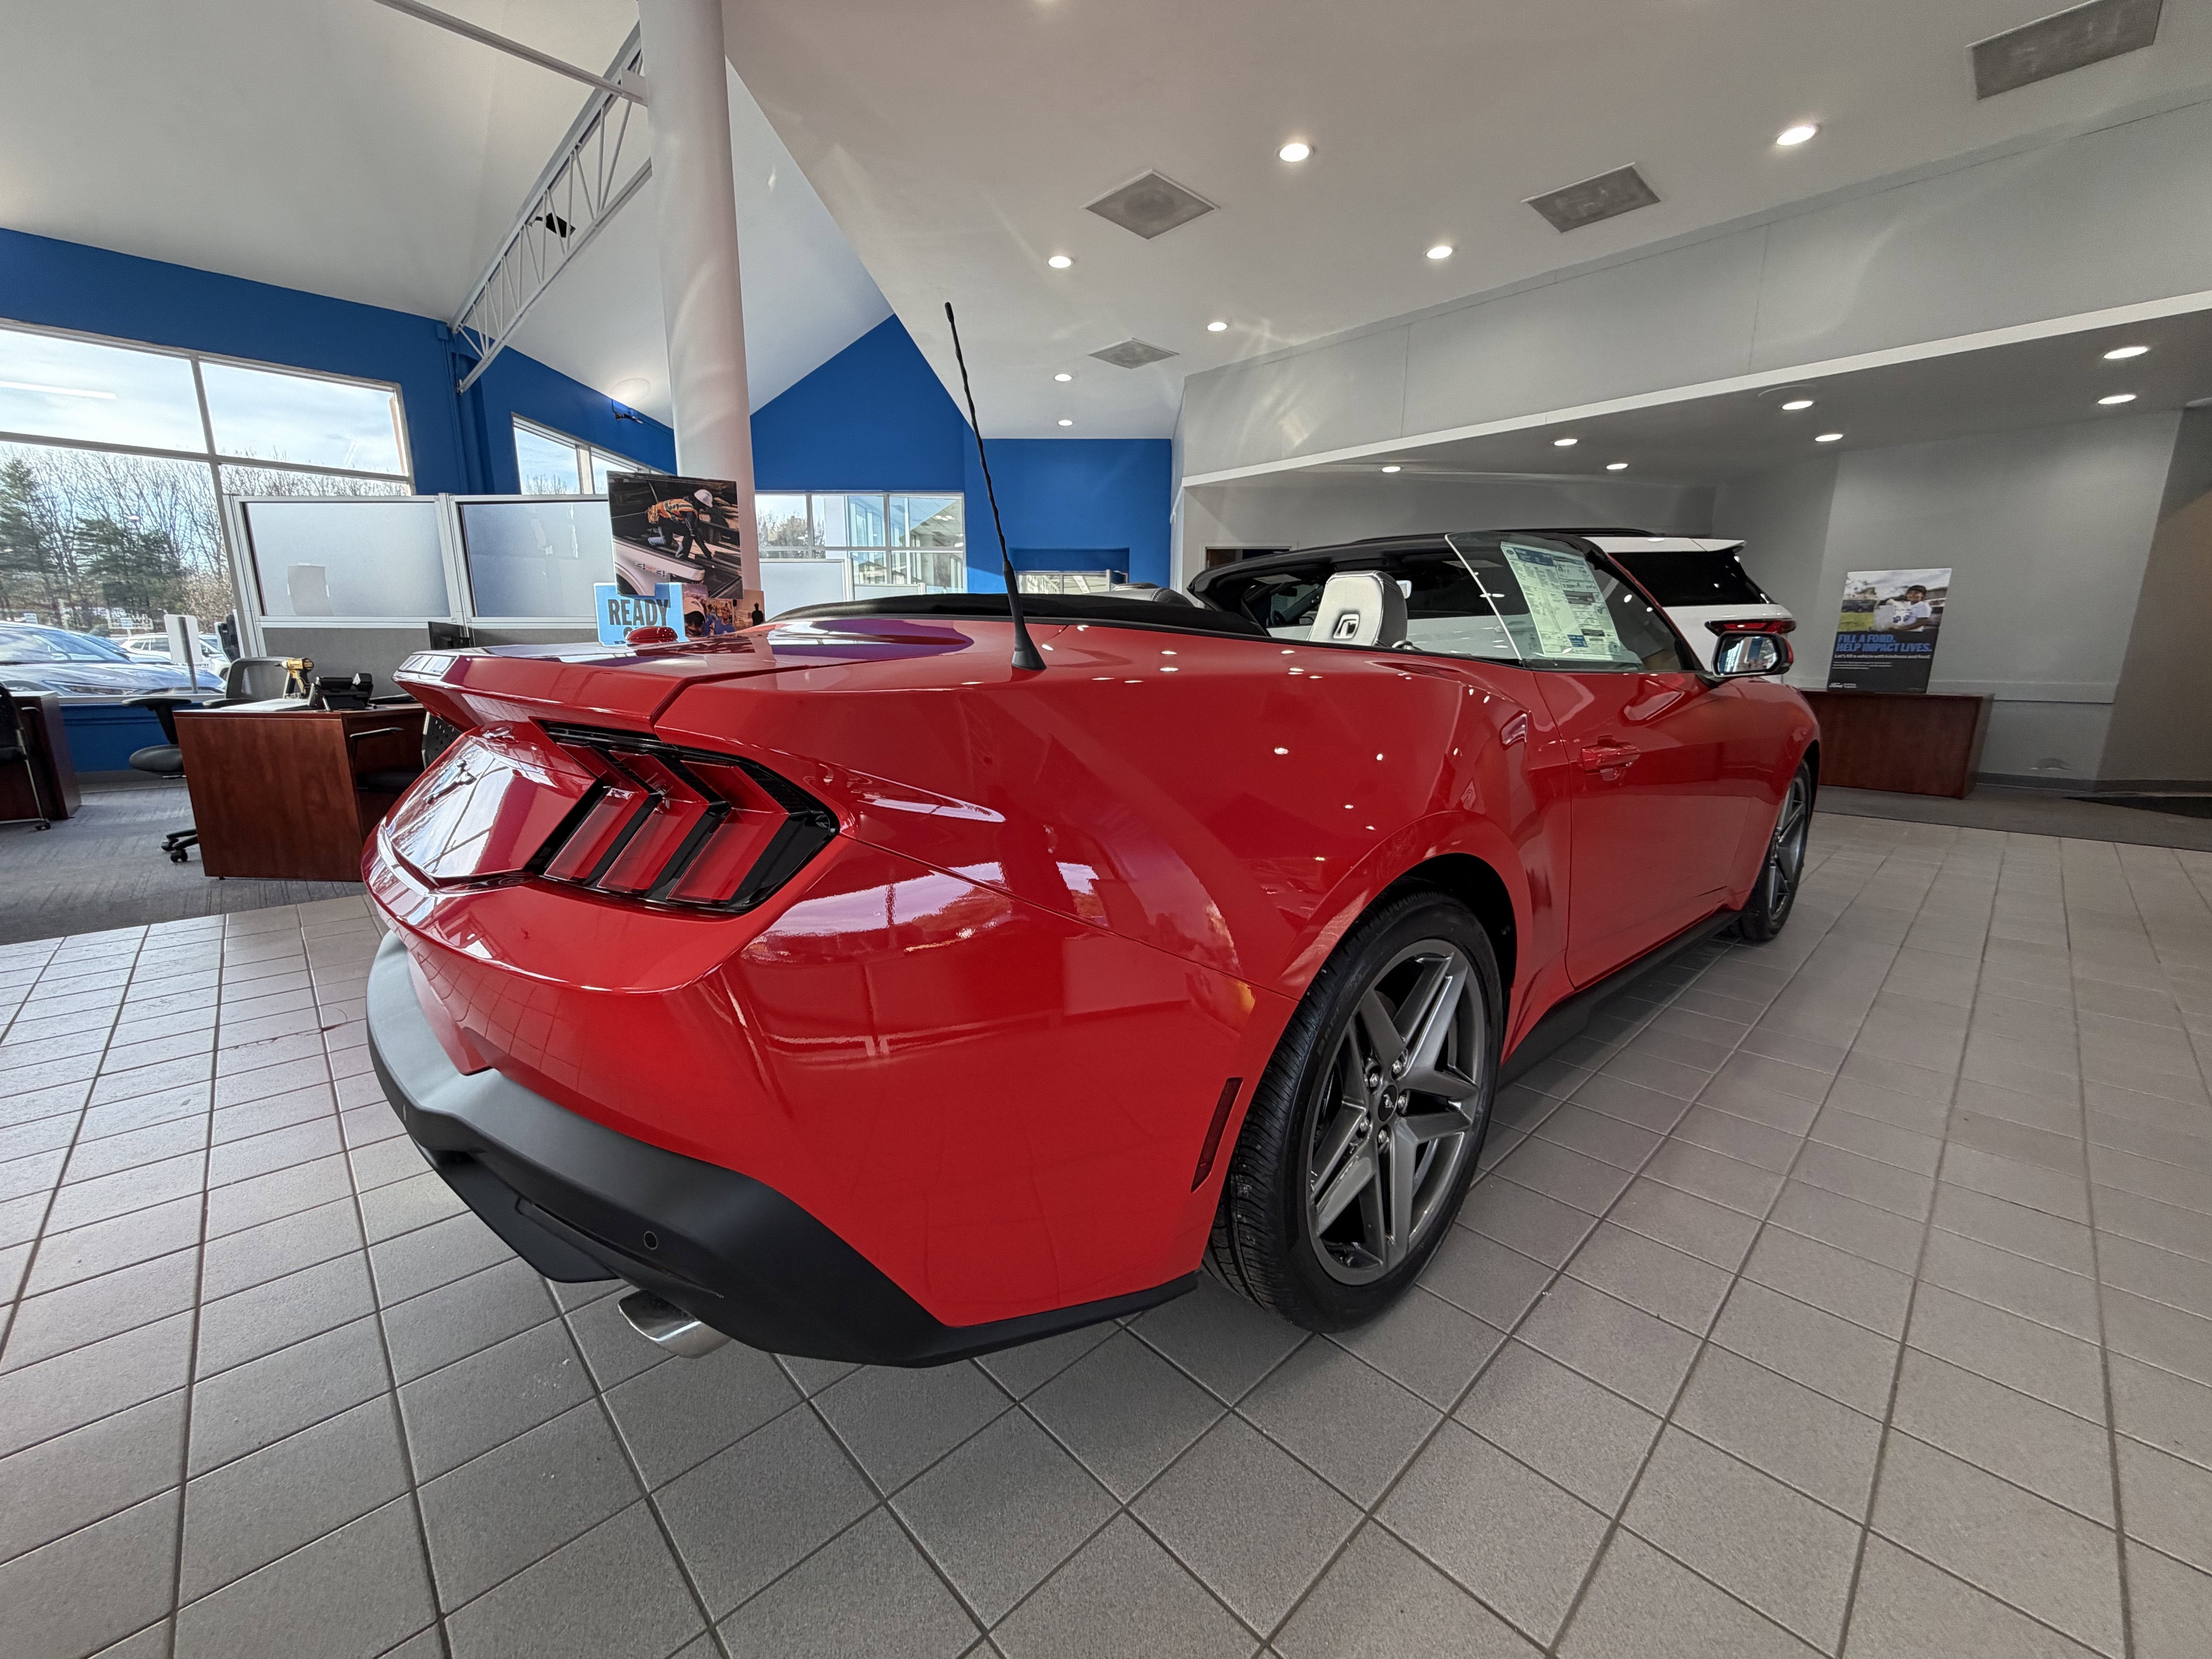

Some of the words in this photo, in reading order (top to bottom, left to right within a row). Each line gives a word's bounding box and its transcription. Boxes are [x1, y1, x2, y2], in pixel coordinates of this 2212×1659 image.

[608, 599, 669, 626] READY
[1838, 634, 1856, 643] FILL
[1858, 634, 1865, 643] A
[1836, 643, 1861, 651] HELP
[1862, 643, 1900, 652] IMPACT
[1900, 643, 1933, 652] LIVES.
